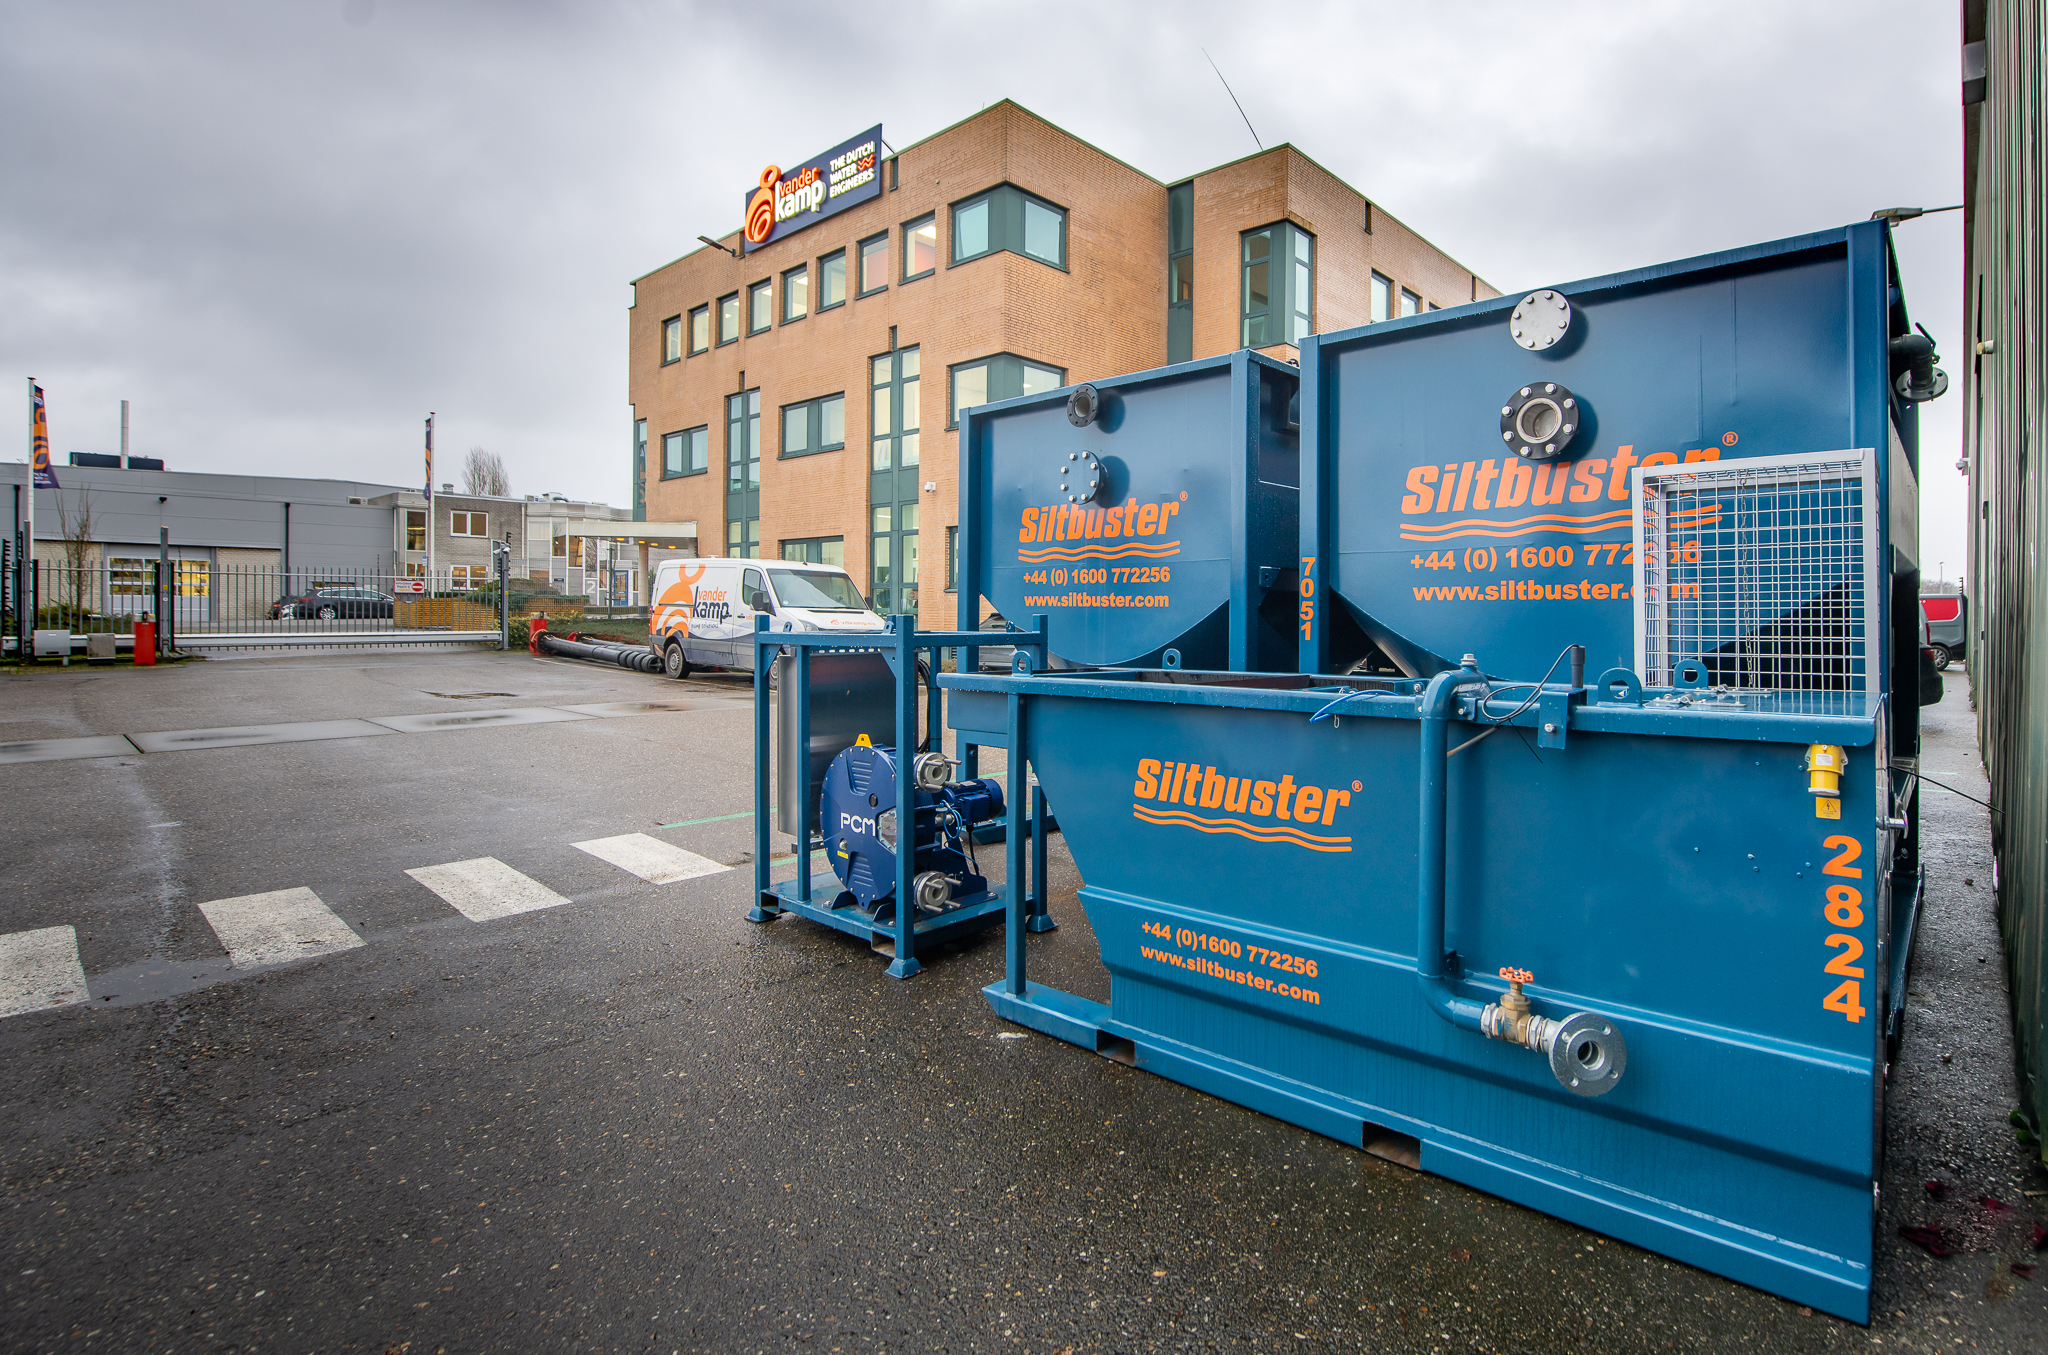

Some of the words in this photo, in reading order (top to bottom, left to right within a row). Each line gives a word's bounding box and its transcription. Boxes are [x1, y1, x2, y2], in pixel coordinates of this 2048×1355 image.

[830, 155, 847, 172] THE
[846, 141, 875, 165] DUTCH
[780, 167, 821, 197] vander
[829, 168, 875, 198] ENGINEERS
[830, 163, 858, 185] WATER
[775, 180, 826, 222] kamp
[1411, 551, 1456, 571] +44
[1463, 546, 1498, 573] (0)
[1505, 546, 1574, 568] 1600
[586, 581, 596, 594] 2
[1023, 570, 1047, 585] +44
[1050, 568, 1068, 587] (0)
[1071, 569, 1107, 584] 1600
[1111, 567, 1171, 584] 772256
[692, 586, 730, 625] kamp
[698, 587, 727, 602] vander
[1023, 591, 1170, 608] www.siltbuster.com
[1300, 557, 1316, 640] 7051
[840, 811, 876, 837] PCM
[1822, 834, 1866, 1024] 2824
[1141, 921, 1172, 941] +44
[1246, 944, 1319, 978] 772256
[1140, 945, 1321, 1005] www.siltbuster.com
